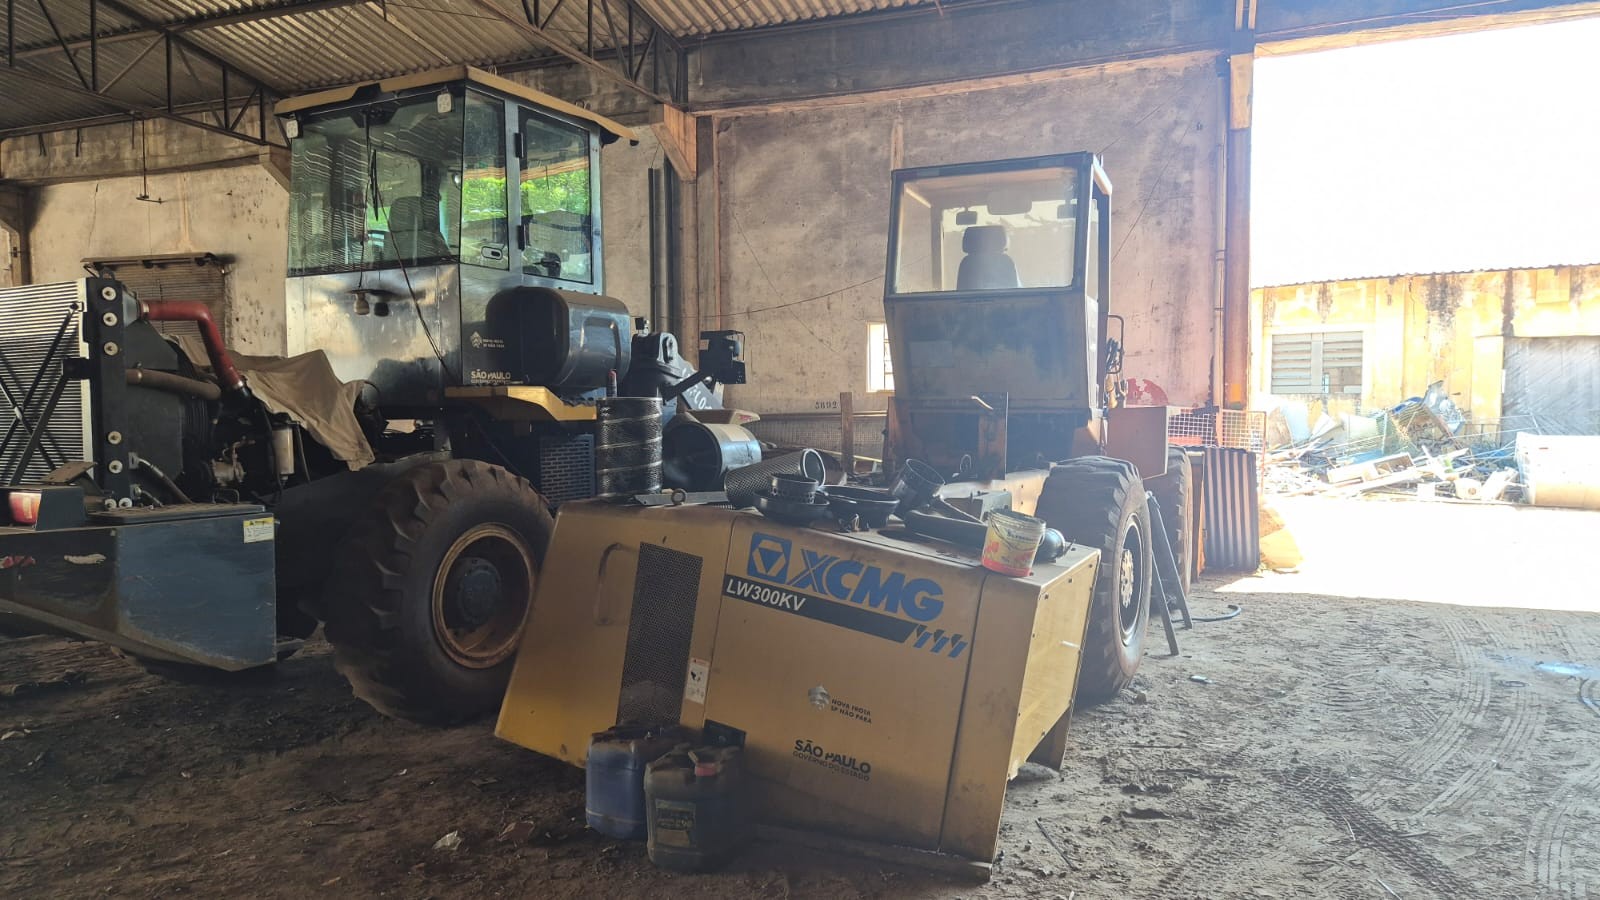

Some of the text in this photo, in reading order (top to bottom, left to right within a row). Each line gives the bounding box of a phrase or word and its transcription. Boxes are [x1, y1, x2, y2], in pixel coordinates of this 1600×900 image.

[471, 369, 487, 379] SÃO
[726, 579, 806, 611] LW300KV
[785, 549, 943, 621] XCMG
[831, 699, 850, 709] NOVA
[839, 708, 854, 717] NÃO
[855, 713, 872, 724] PARA
[792, 750, 870, 782] GOVERNO DO ESTADO
[794, 739, 871, 774] SÃO PAULO
